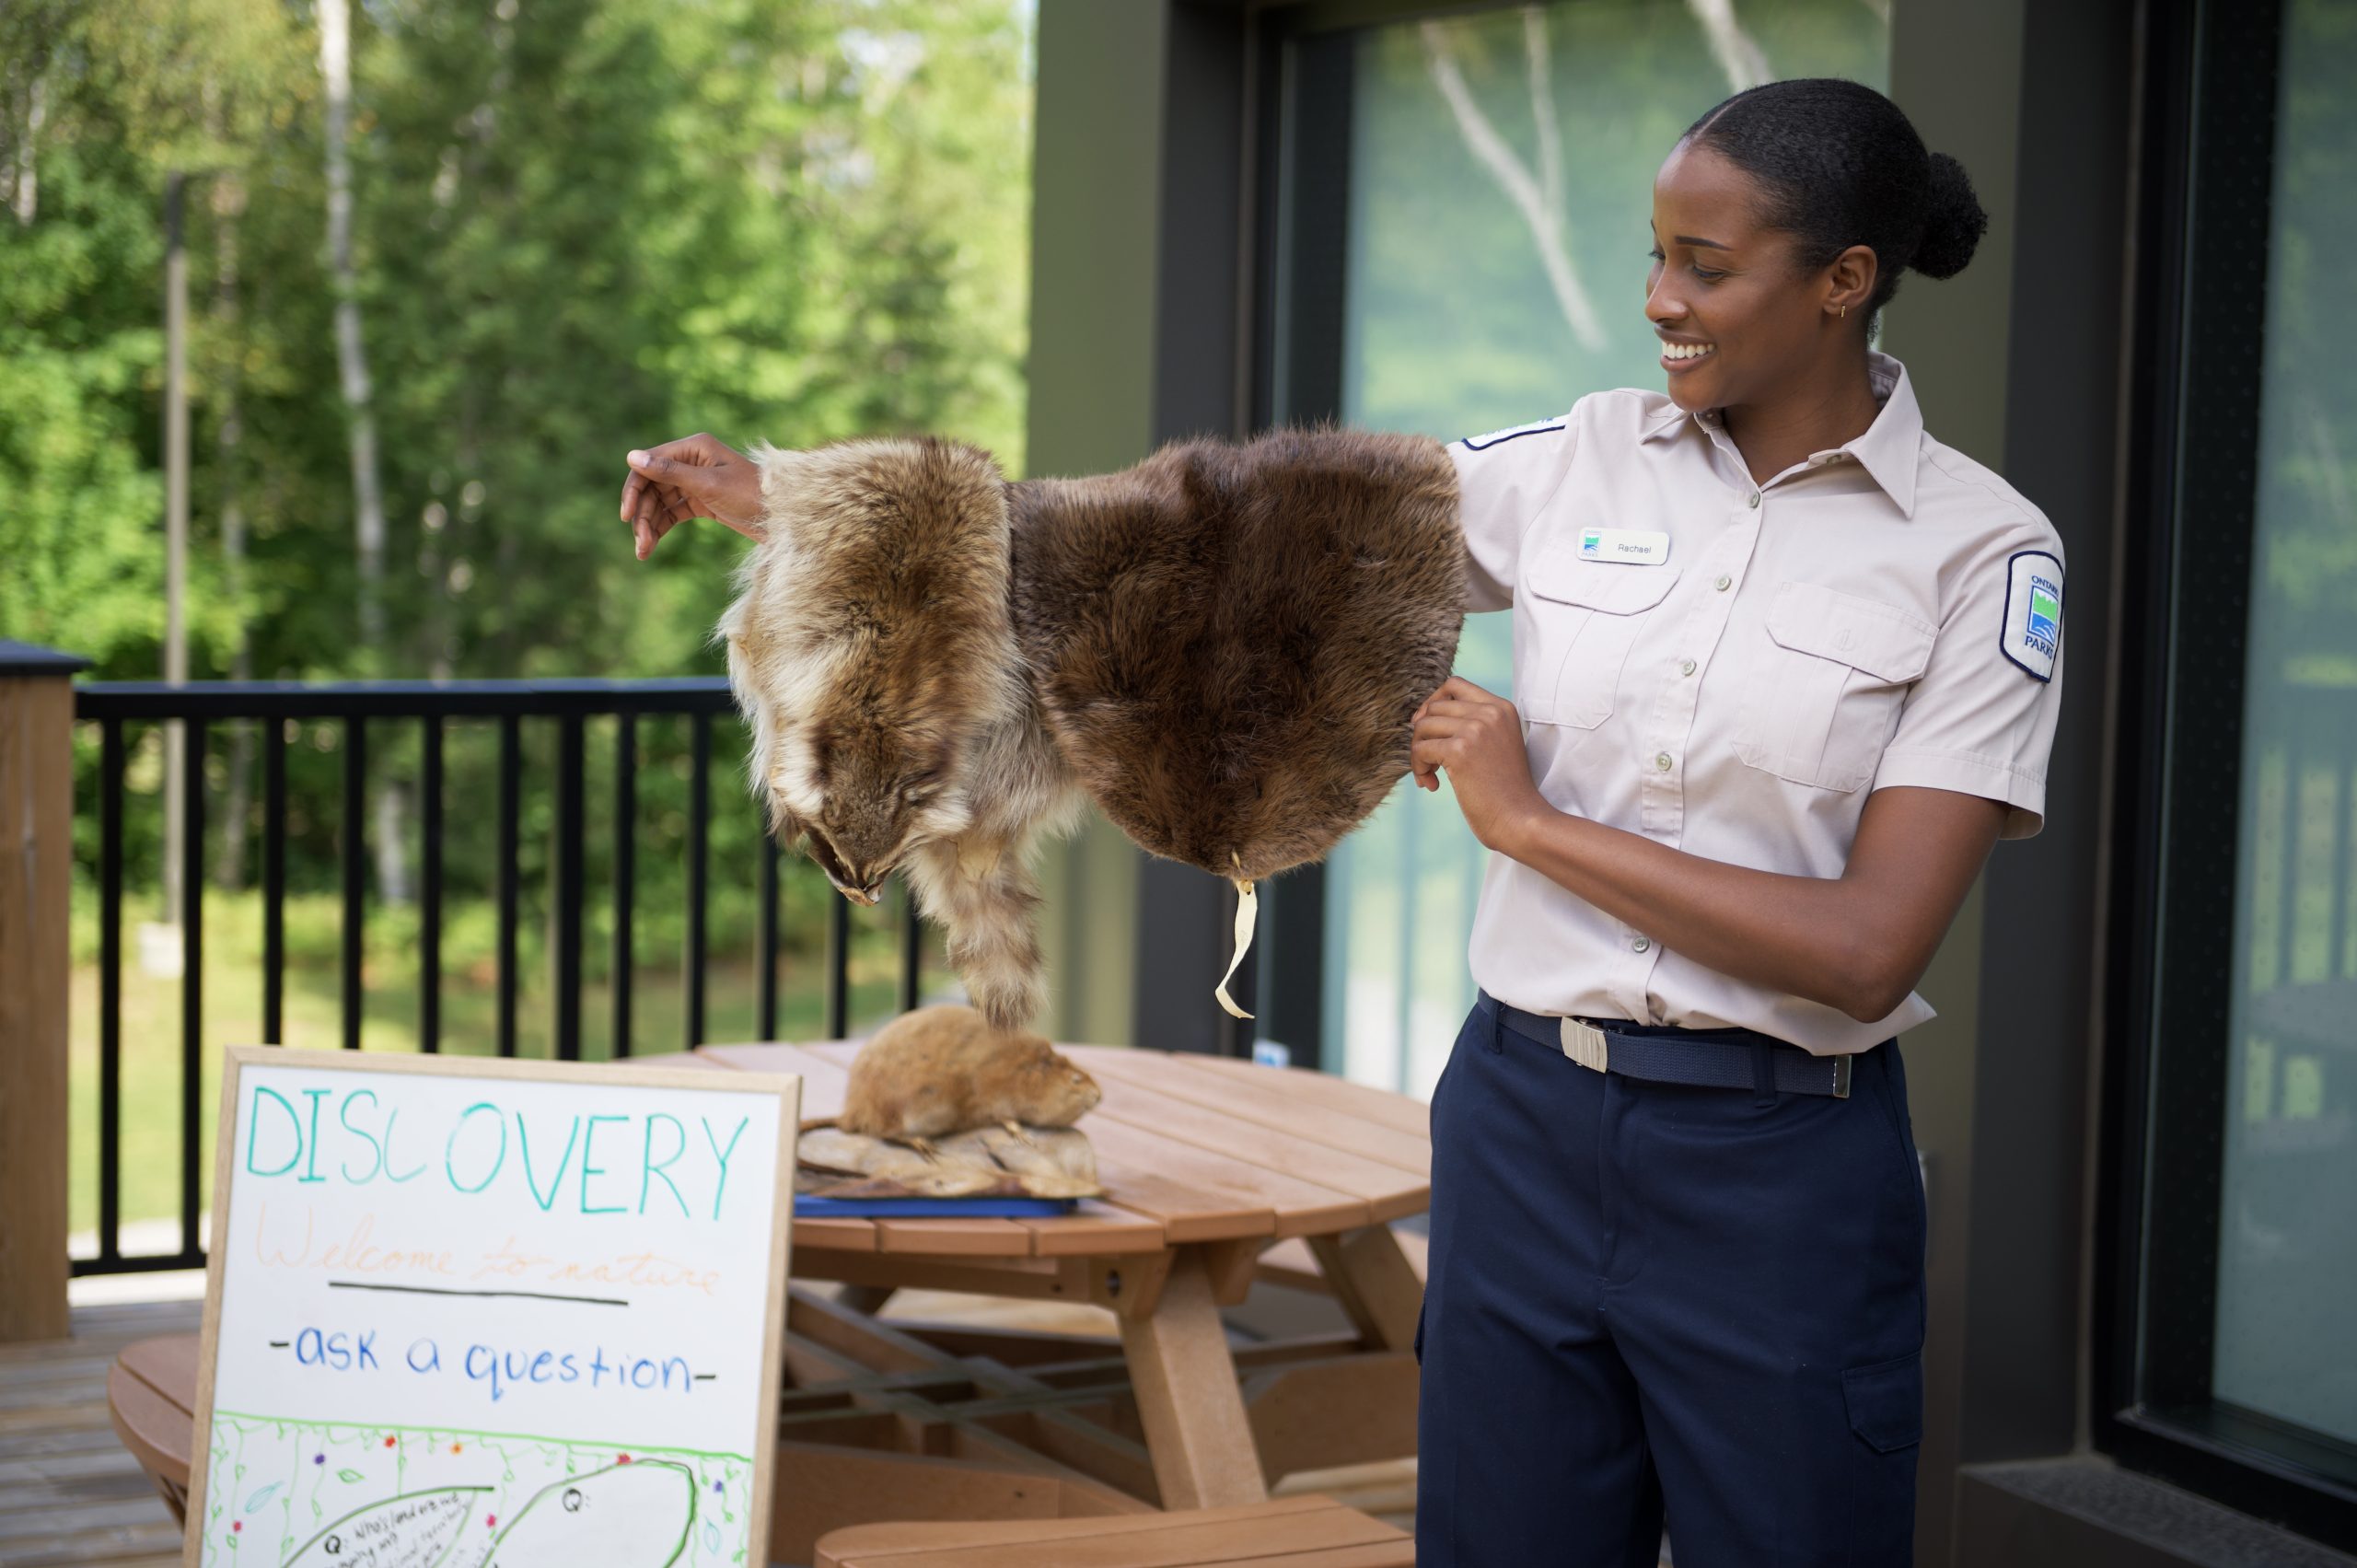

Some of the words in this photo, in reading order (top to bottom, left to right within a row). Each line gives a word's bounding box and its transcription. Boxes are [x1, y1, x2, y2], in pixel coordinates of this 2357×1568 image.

[1618, 543, 1652, 554] Rachael
[2025, 635, 2054, 660] PARKS
[247, 1085, 750, 1221] DISCOVERY
[255, 1200, 459, 1276] Welcome
[470, 1236, 554, 1282] to
[547, 1251, 722, 1297] nature
[406, 1337, 441, 1373] a
